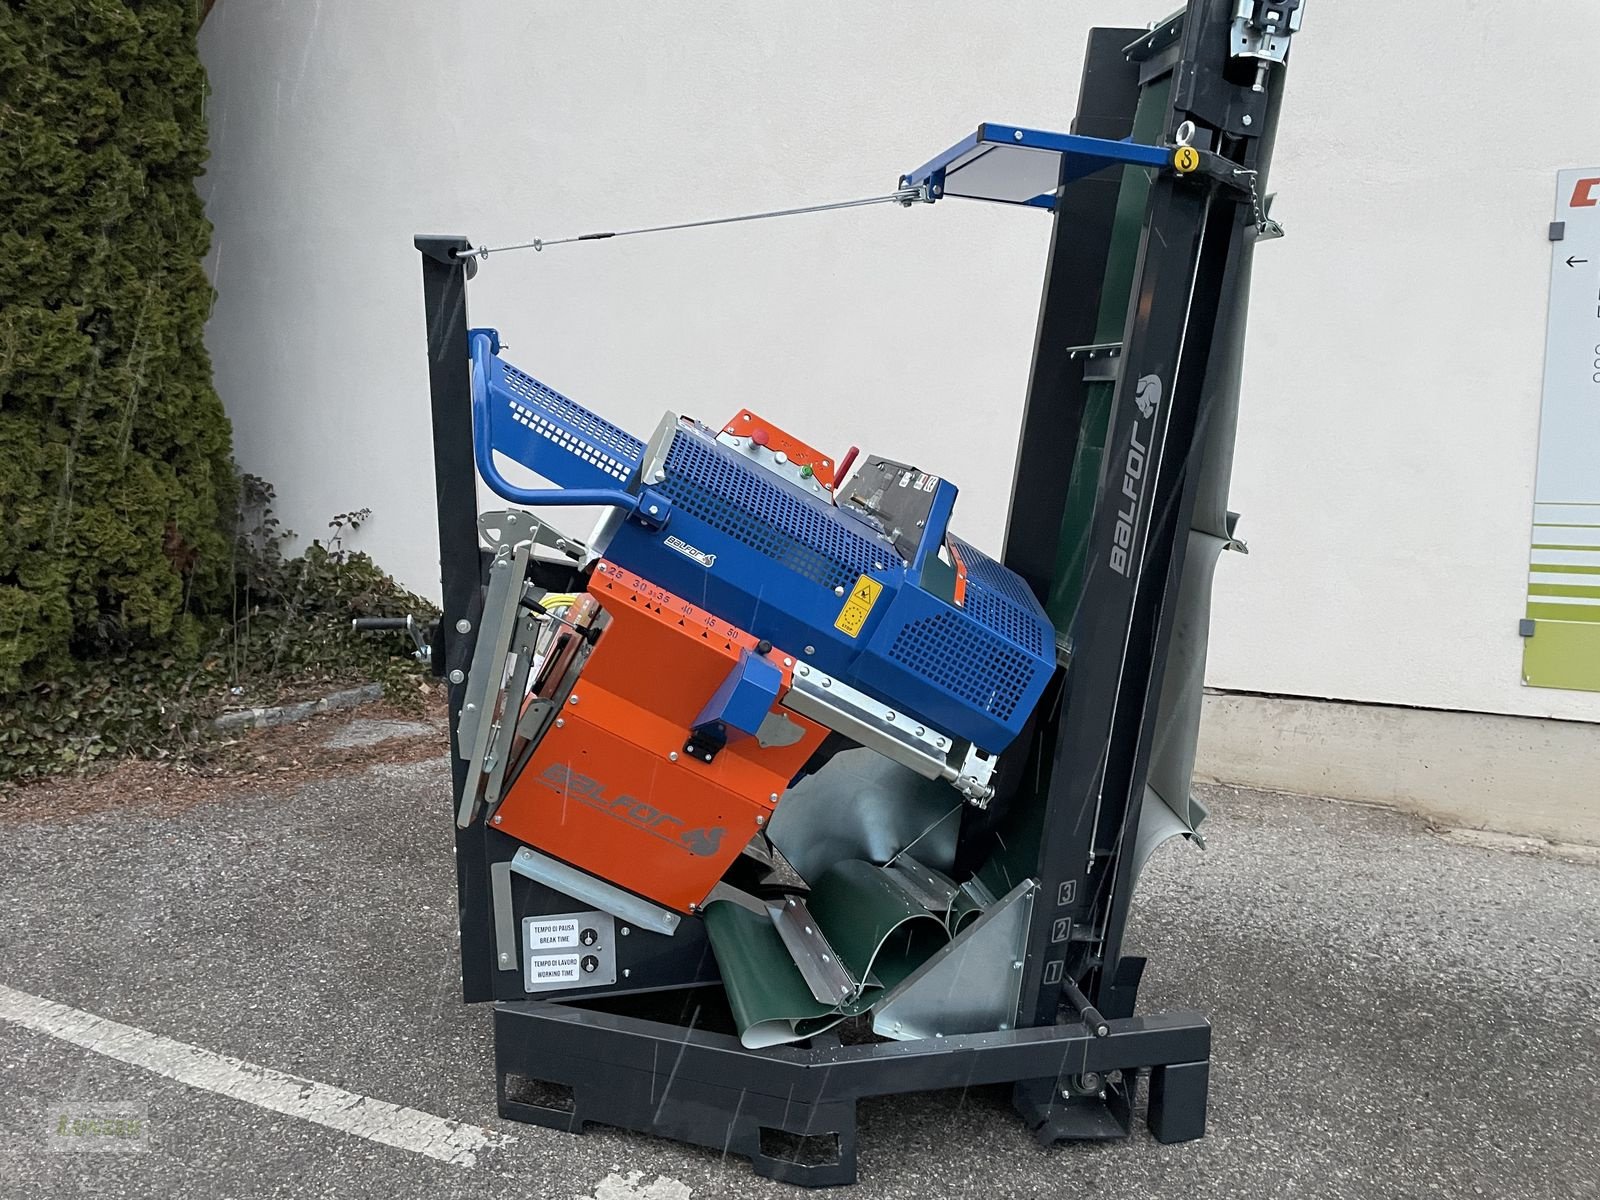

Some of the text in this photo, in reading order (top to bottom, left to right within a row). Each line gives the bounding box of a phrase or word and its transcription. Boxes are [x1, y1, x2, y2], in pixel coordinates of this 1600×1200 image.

[608, 567, 623, 579] 25
[633, 579, 647, 591] 30
[657, 592, 670, 603] 35
[681, 604, 693, 615] 40
[705, 617, 716, 627] 45
[727, 628, 739, 639] 50
[1062, 883, 1071, 902] 3
[1057, 921, 1066, 939] 2
[539, 936, 556, 944] BREAK
[534, 960, 551, 968] TEMPO
[537, 969, 574, 978] WORKING TIME
